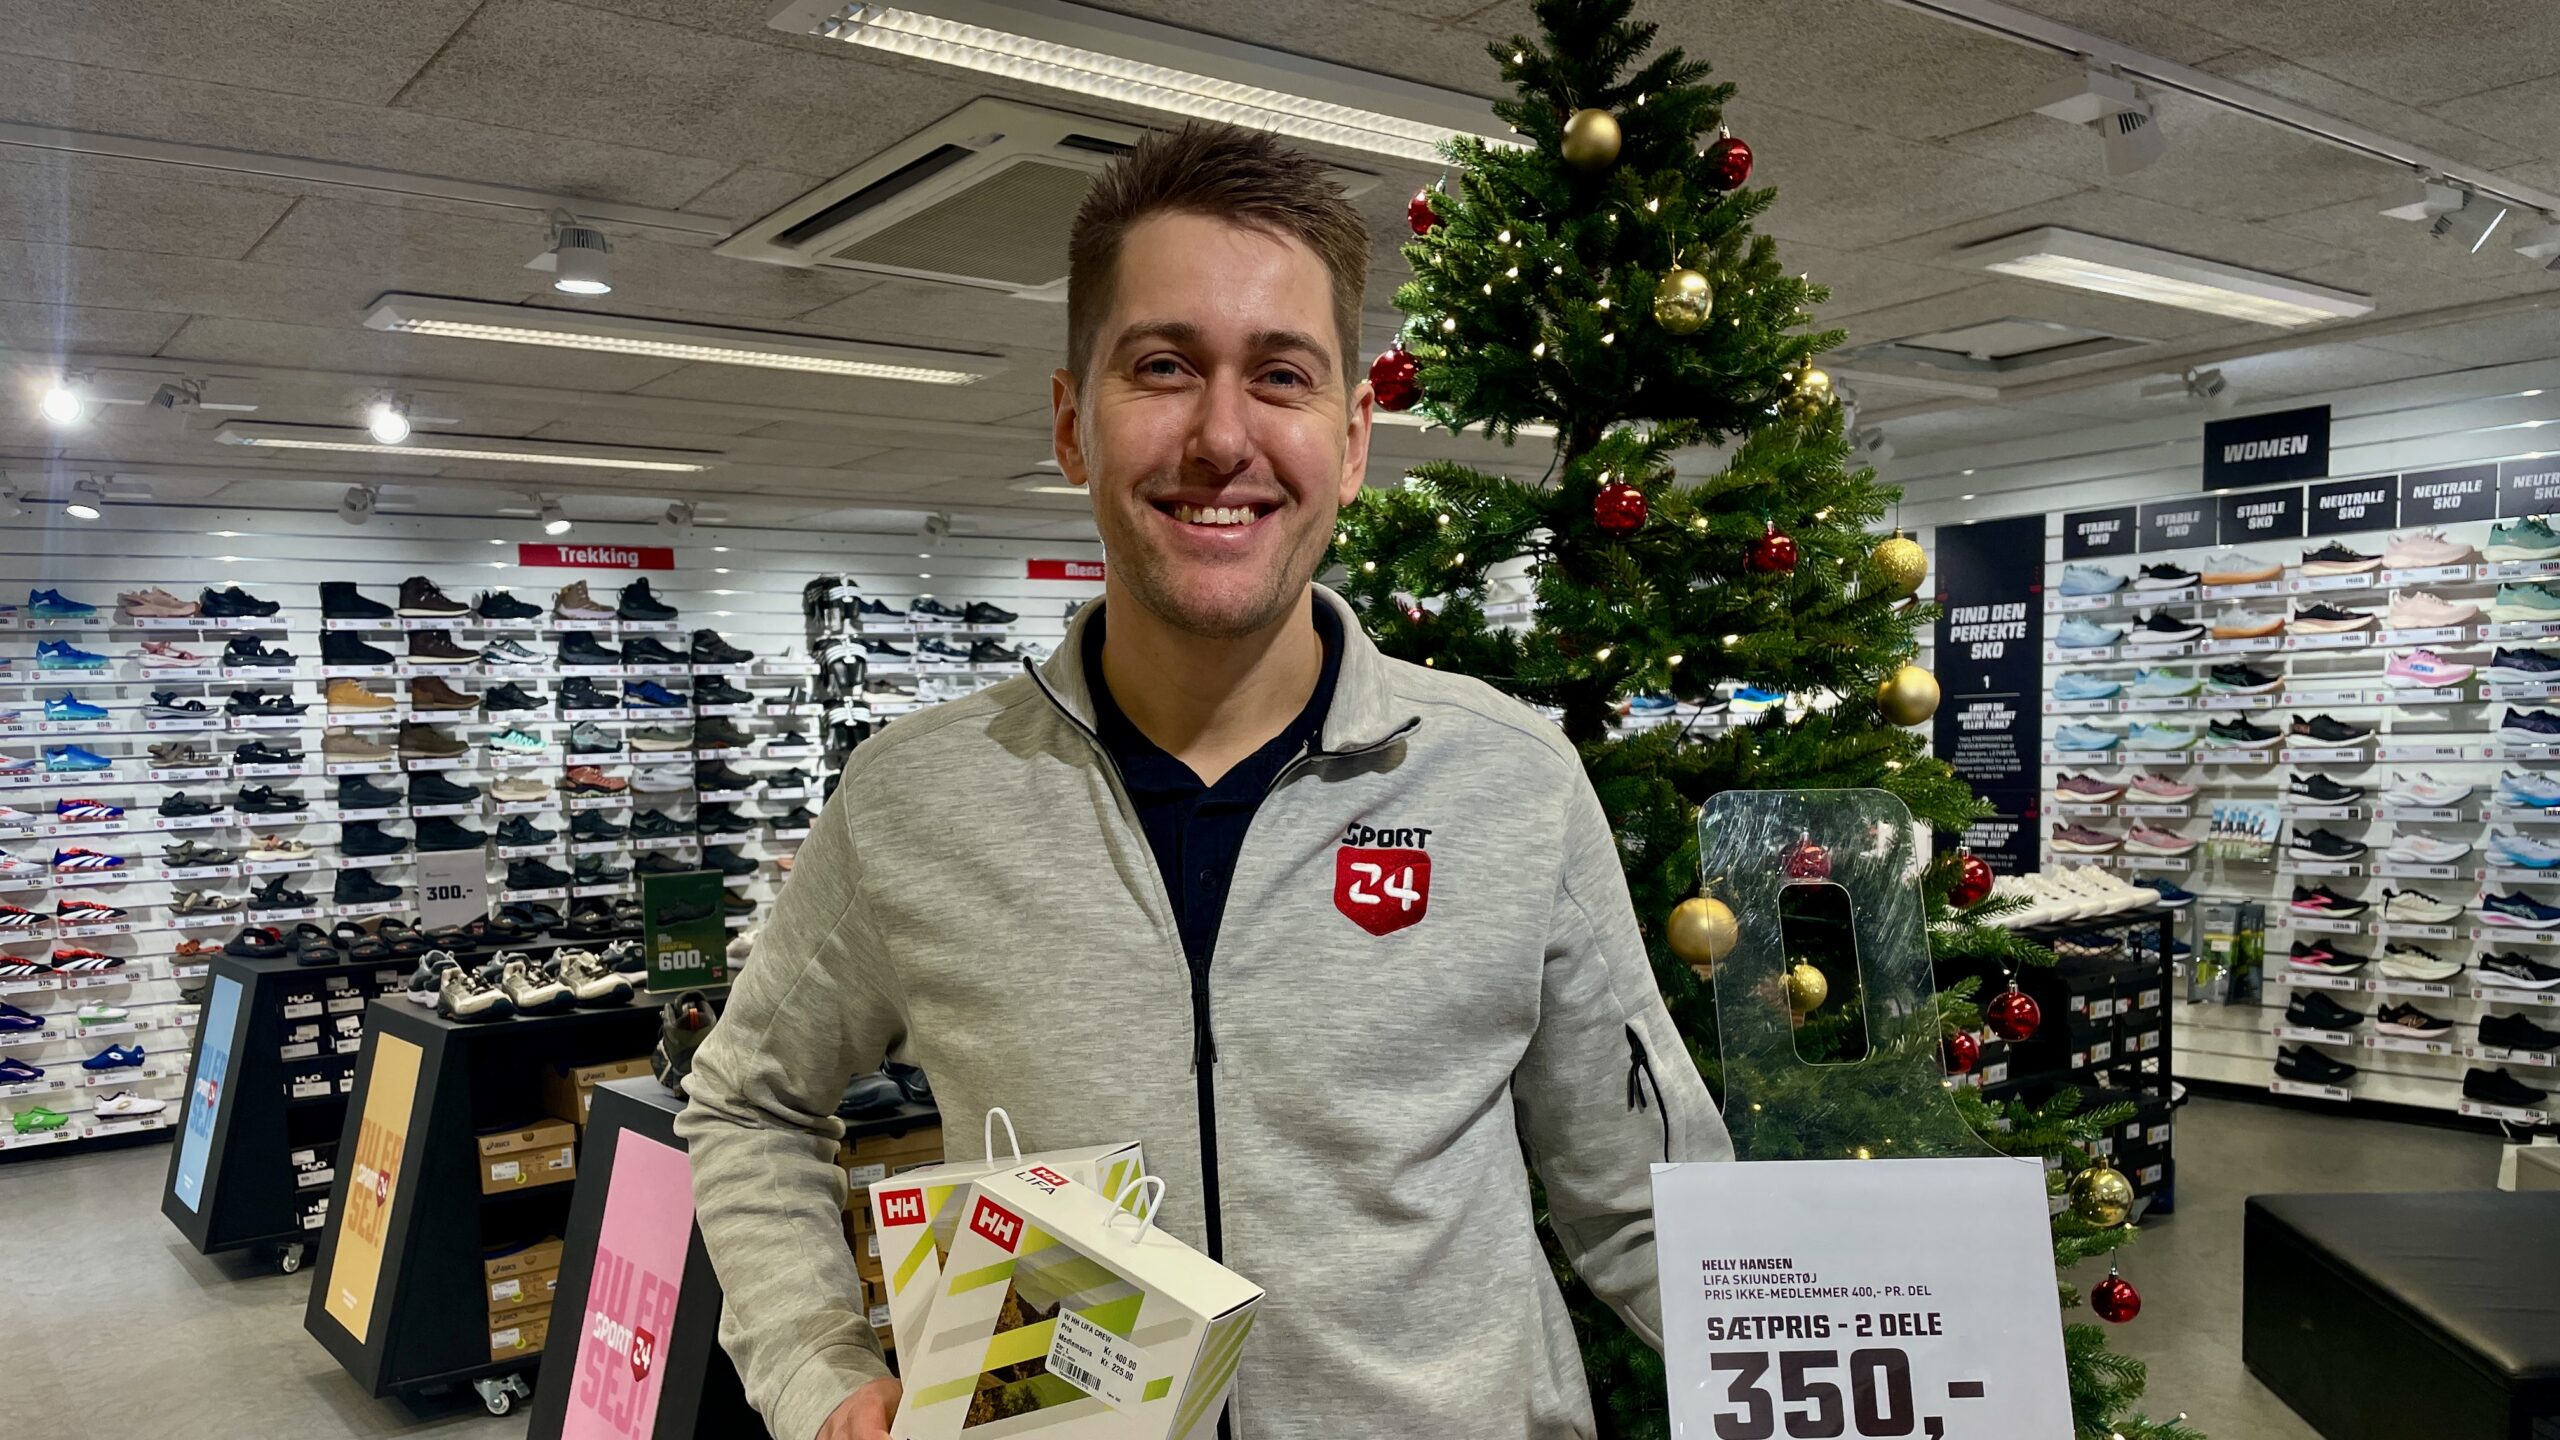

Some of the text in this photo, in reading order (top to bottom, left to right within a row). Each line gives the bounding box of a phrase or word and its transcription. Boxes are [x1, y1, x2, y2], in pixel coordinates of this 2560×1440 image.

[2224, 435, 2309, 464] WOMEN
[2320, 490, 2386, 509] NEUTRALE
[2413, 479, 2483, 499] NEUTRALE
[2237, 501, 2285, 518] STABILE
[2338, 506, 2365, 520] SKO
[2433, 495, 2461, 510] SKO
[2078, 520, 2121, 536] STABILE
[2156, 511, 2201, 527] STABILE
[2248, 516, 2273, 530] SKO
[2088, 533, 2110, 546] SKO
[2166, 524, 2190, 538] SKO
[558, 546, 640, 567] Trekking
[1951, 602, 2026, 625] FIND DEN
[1950, 621, 2027, 643] PERFEKTE
[1970, 641, 2004, 660] SKO
[1983, 675, 1990, 689] 1
[1342, 822, 1432, 849] SPORT
[426, 885, 473, 901] 300.-
[1349, 862, 1421, 912] 24
[659, 949, 710, 971] 600,-
[1015, 1171, 1056, 1195] LIFA
[1036, 1169, 1063, 1184] HH
[886, 1196, 919, 1219] HH
[978, 1205, 1015, 1242] HH
[1702, 1258, 1793, 1271] HELLY HANSEN
[1703, 1272, 1818, 1286] LIFA SKIUNDERTØJ
[587, 1245, 678, 1359] DU ER
[1705, 1285, 1932, 1300] PRIS IKKE-MEDLEMMER 400,- PR. DEL
[1064, 1313, 1113, 1343] W HH LIFA CREW
[1707, 1314, 1830, 1340] SÆTPRIS
[1855, 1313, 1873, 1337] 2
[1879, 1312, 1943, 1337] DELE
[593, 1311, 651, 1371] SPORT 24
[1061, 1322, 1137, 1371] Pris Kr. 400.00
[1058, 1333, 1093, 1357] Medlemspris
[1100, 1357, 1110, 1368] Kr.
[1112, 1363, 1134, 1381] 225.00
[579, 1338, 650, 1440] SEJ!
[1710, 1347, 1985, 1440] 350,-
